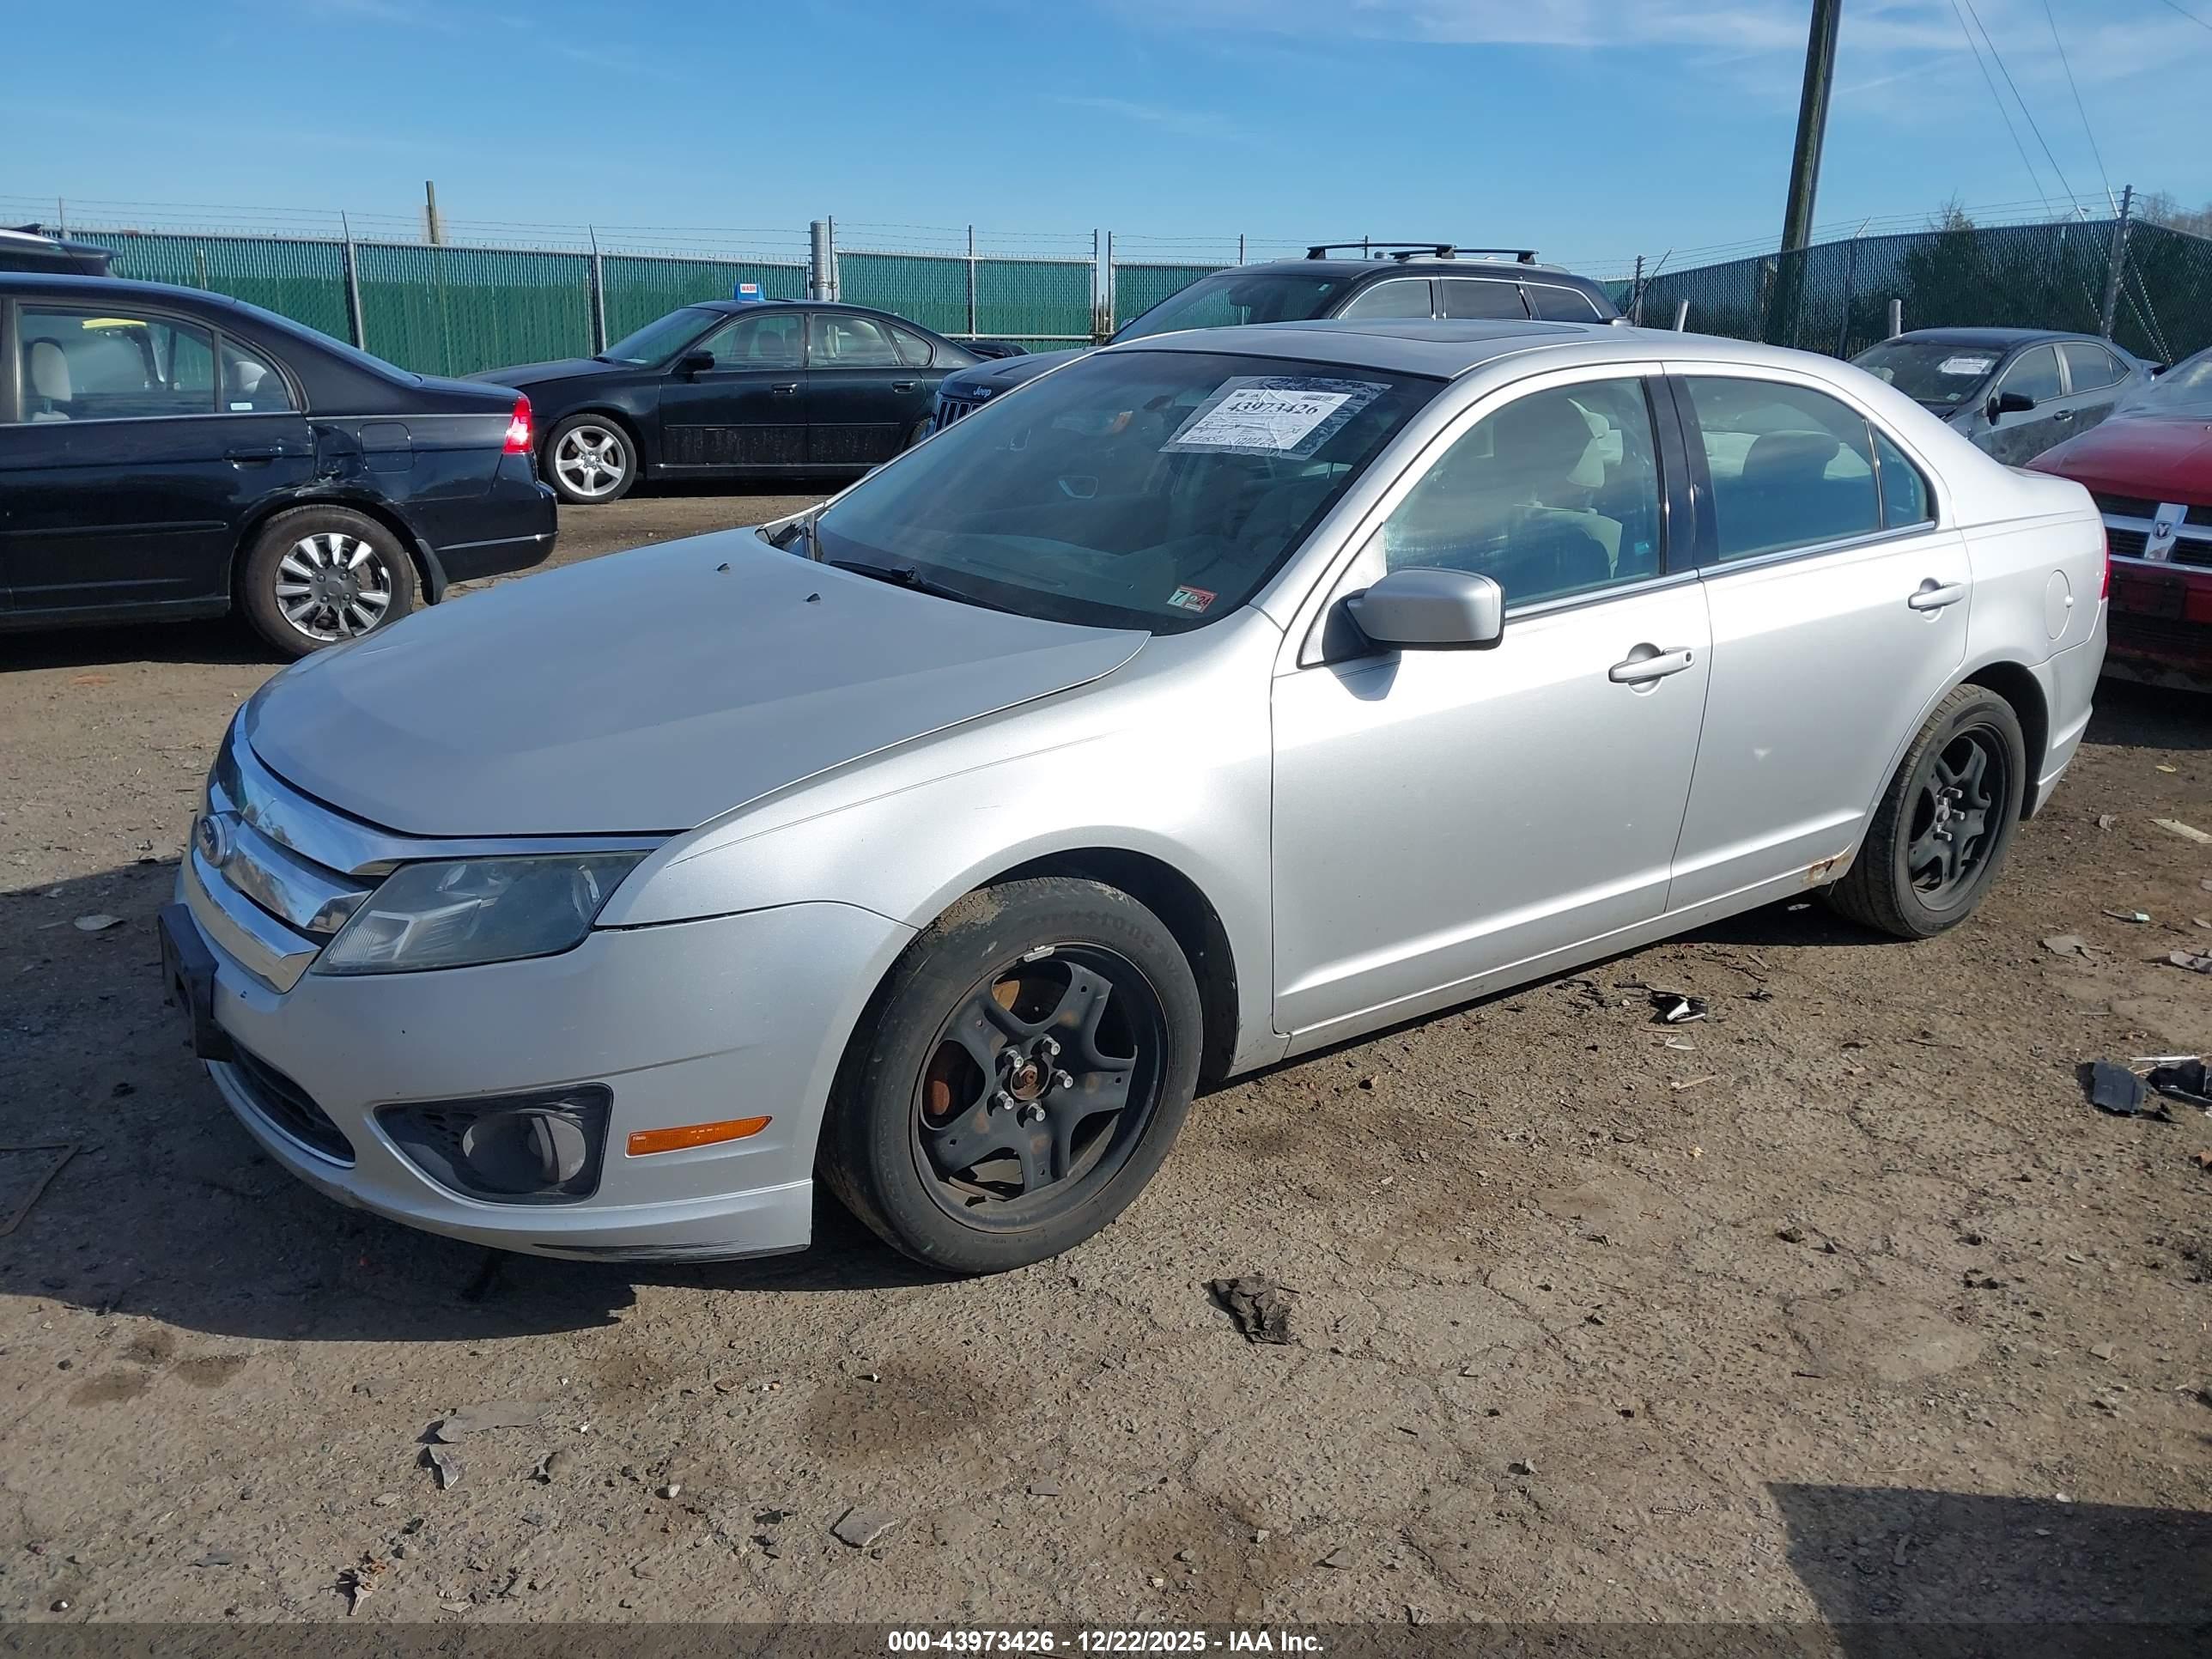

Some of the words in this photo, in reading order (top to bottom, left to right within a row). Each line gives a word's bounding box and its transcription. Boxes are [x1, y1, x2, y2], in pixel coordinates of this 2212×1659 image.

[973, 384, 992, 398] Jeep
[1227, 400, 1319, 416] 43973426
[1174, 591, 1188, 603] 7
[1196, 596, 1212, 607] 24
